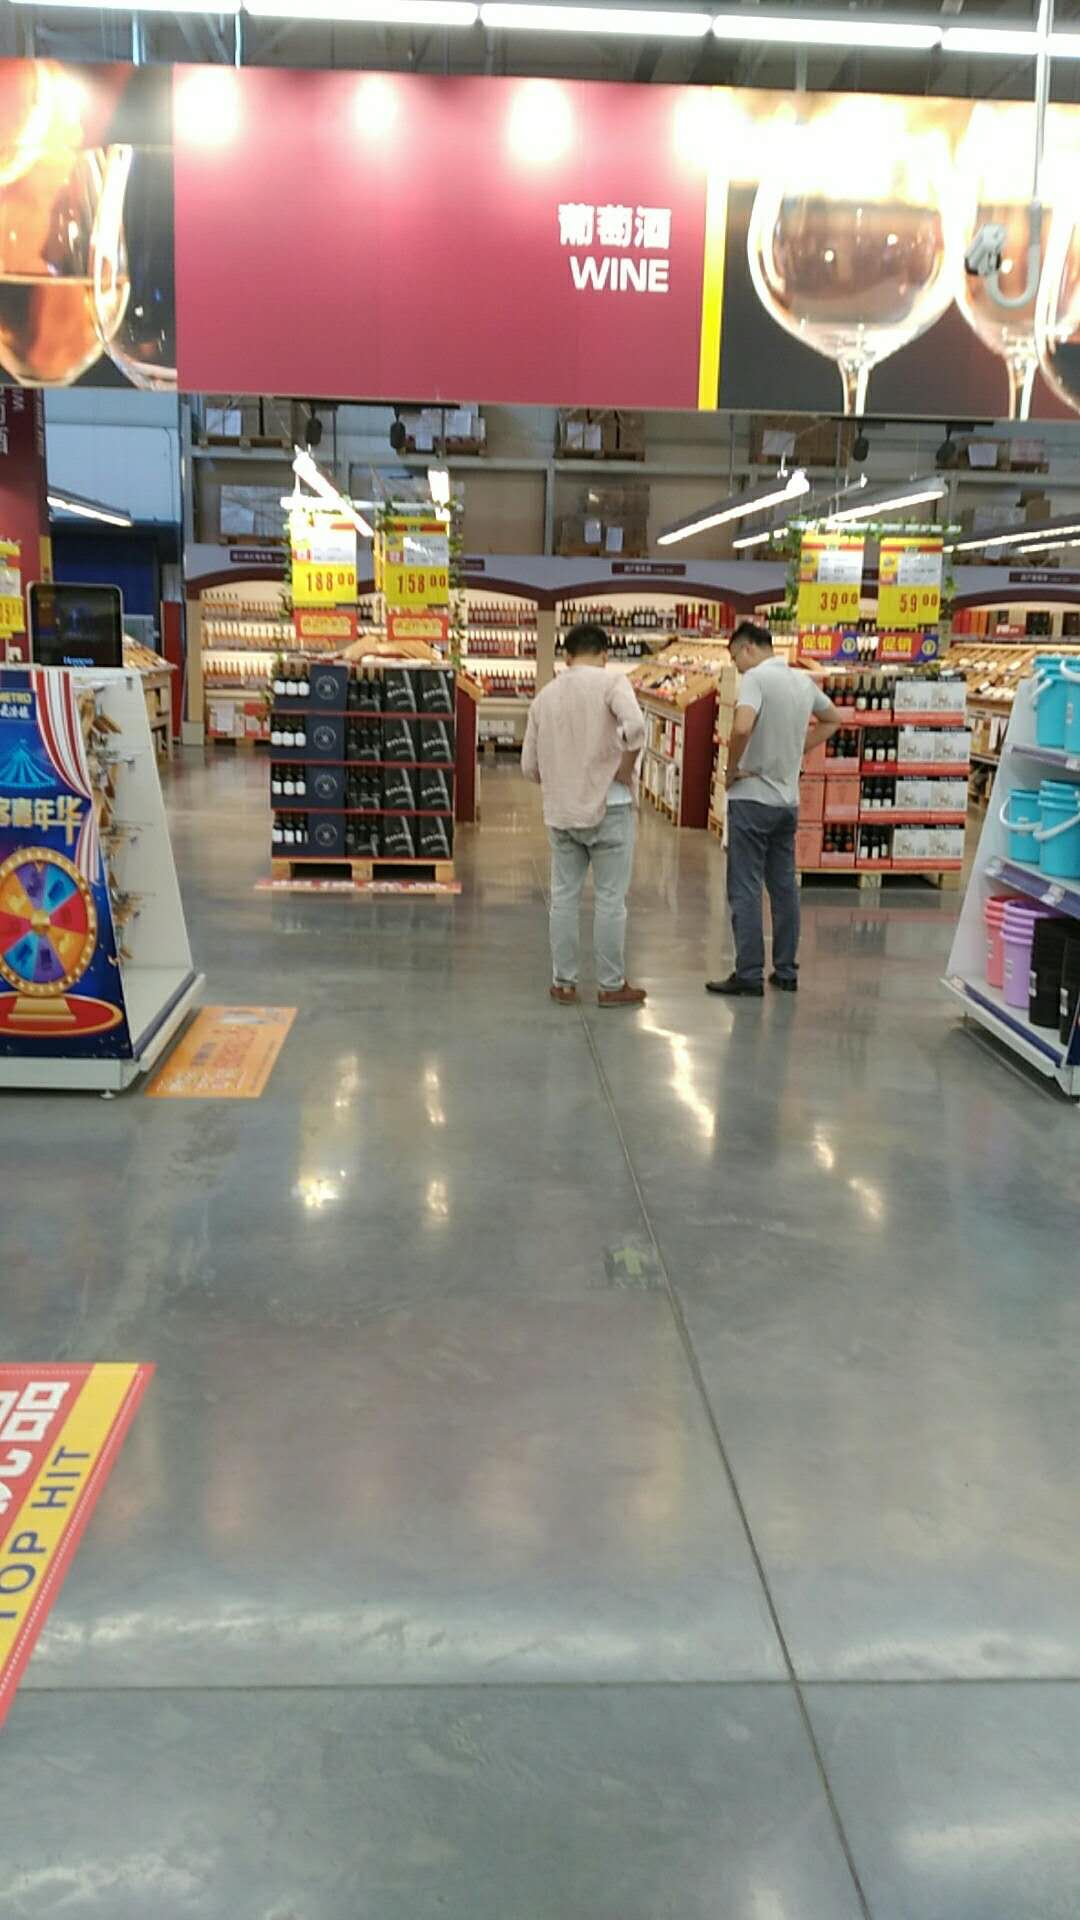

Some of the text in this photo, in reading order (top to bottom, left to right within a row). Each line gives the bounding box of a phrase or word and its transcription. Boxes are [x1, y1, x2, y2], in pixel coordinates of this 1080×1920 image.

[558, 203, 671, 249] 葡萄酒
[570, 256, 669, 293] WINE
[31, 1446, 90, 1509] HIT
